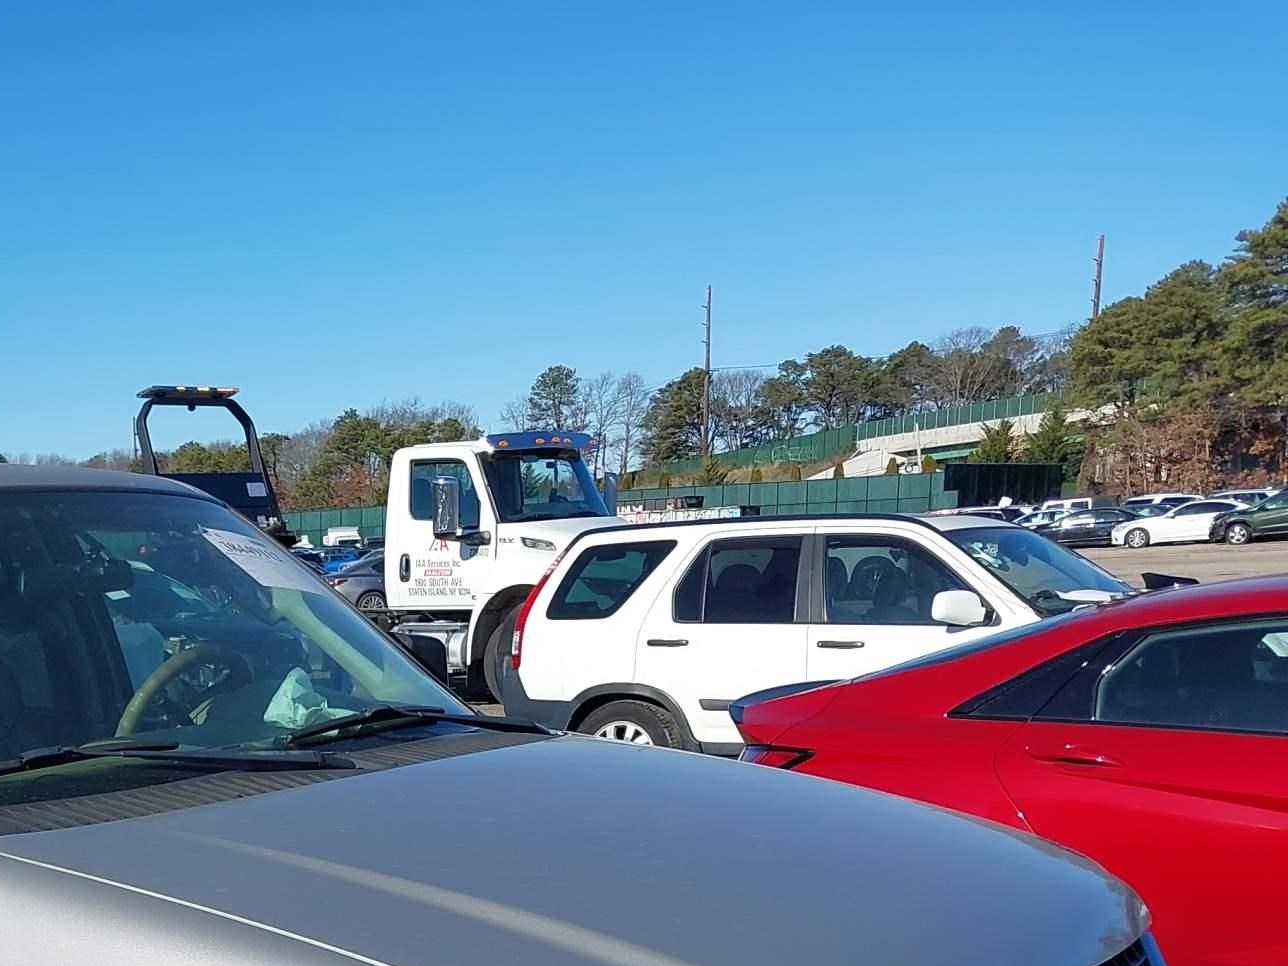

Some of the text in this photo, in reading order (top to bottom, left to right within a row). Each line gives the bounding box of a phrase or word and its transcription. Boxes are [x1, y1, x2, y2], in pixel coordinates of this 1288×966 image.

[428, 577, 449, 587] SOUTH
[450, 577, 463, 587] AVE
[408, 587, 427, 597] STATEN
